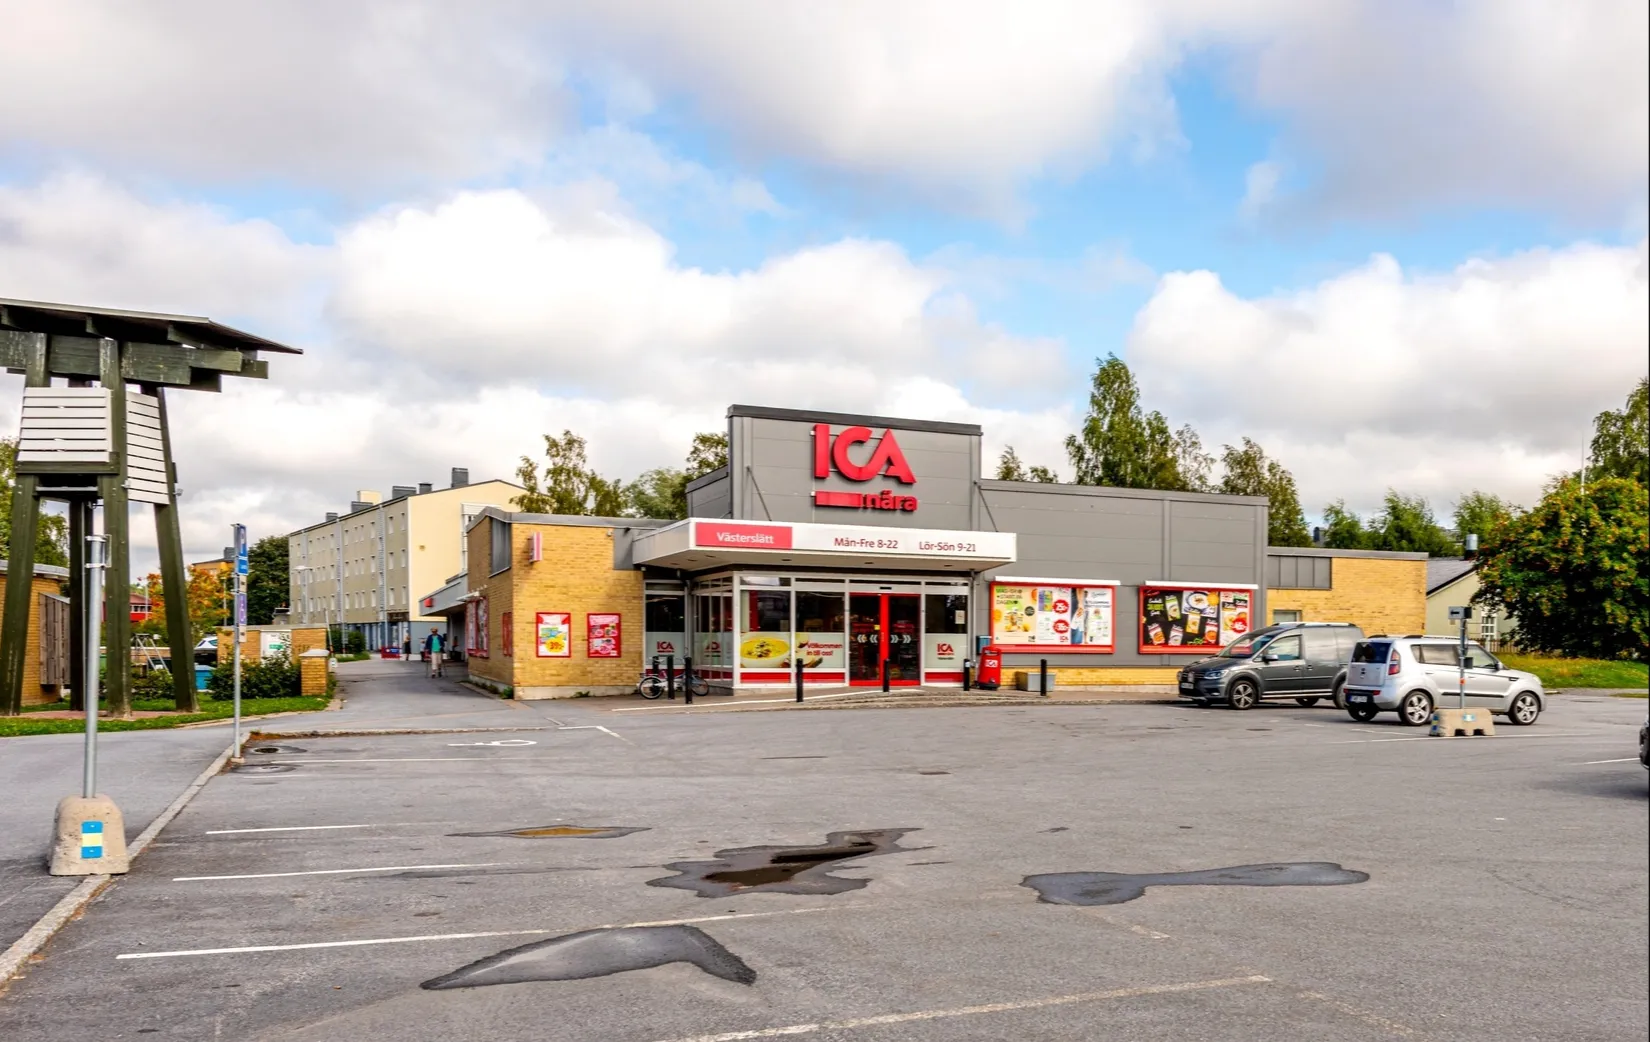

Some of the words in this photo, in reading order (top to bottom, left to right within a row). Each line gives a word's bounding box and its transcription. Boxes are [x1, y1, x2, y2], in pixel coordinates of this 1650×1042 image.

[813, 423, 917, 484] ICA
[863, 490, 918, 511] nära
[716, 531, 775, 544] Västerslätt
[834, 537, 875, 548] Mån-Fre
[877, 540, 898, 549] 8-22
[919, 541, 955, 551] Lör-Sön
[957, 543, 976, 552] 9-21
[657, 641, 674, 650] ICA
[937, 643, 954, 652] ICA
